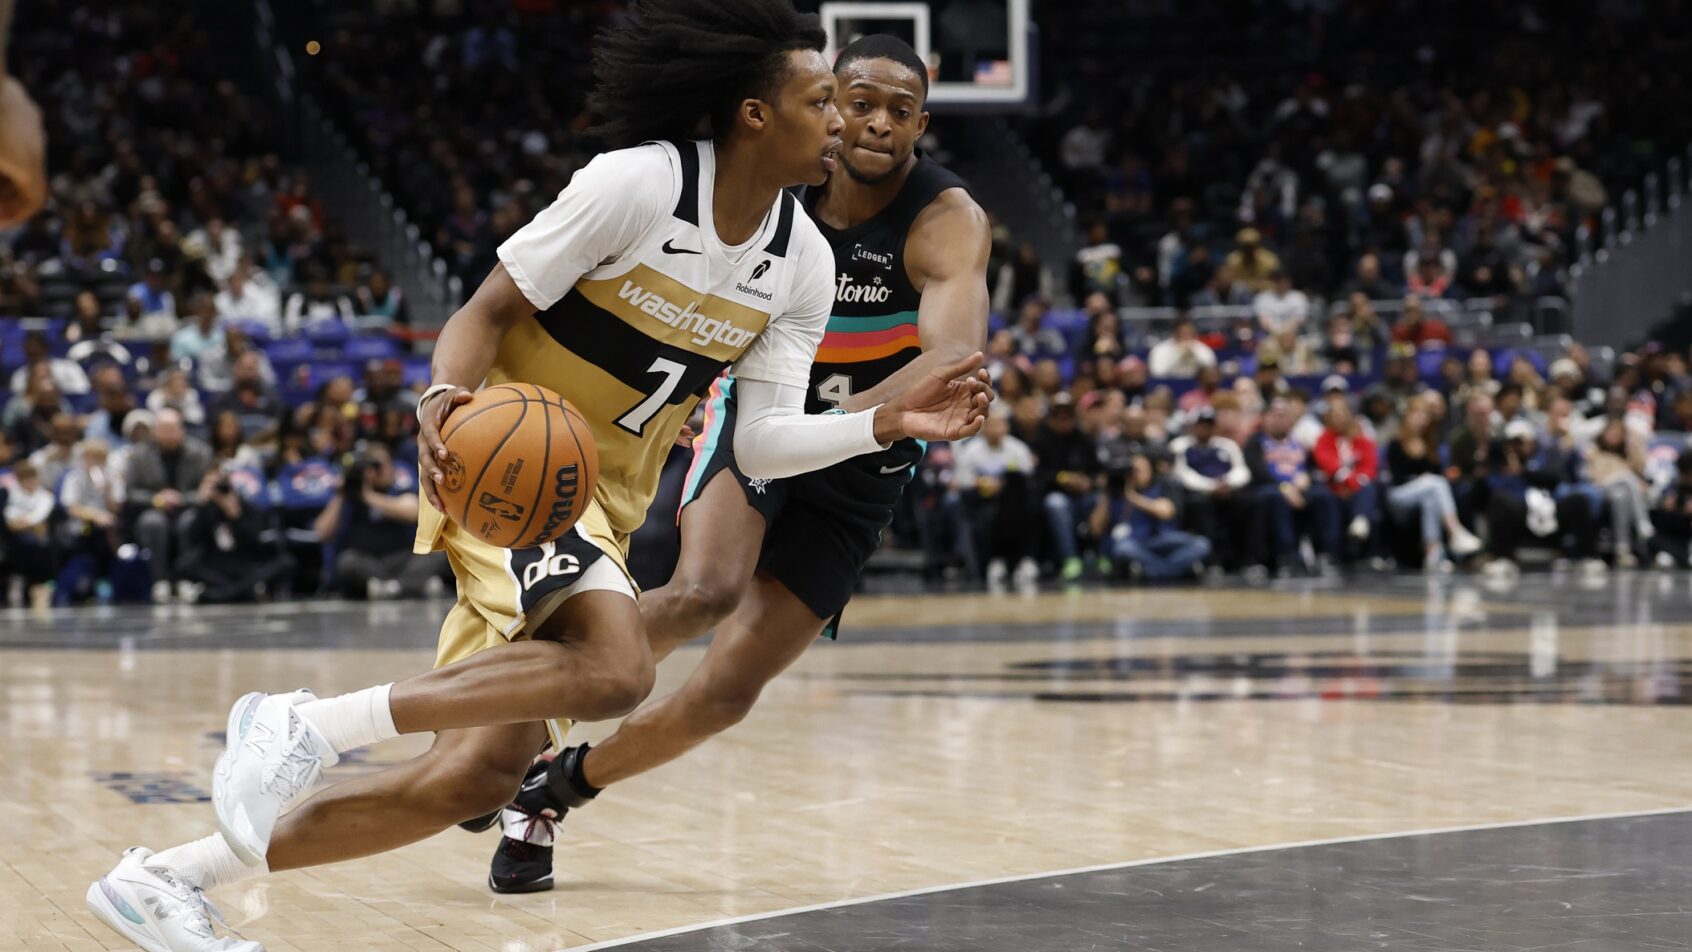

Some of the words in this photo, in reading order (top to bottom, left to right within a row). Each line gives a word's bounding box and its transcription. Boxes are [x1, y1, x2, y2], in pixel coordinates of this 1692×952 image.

[857, 248, 888, 265] LEDGER
[735, 282, 773, 301] Robinhood
[835, 272, 893, 303] tonio
[617, 279, 757, 347] washngton
[612, 355, 688, 438] 7
[815, 372, 853, 409] 4
